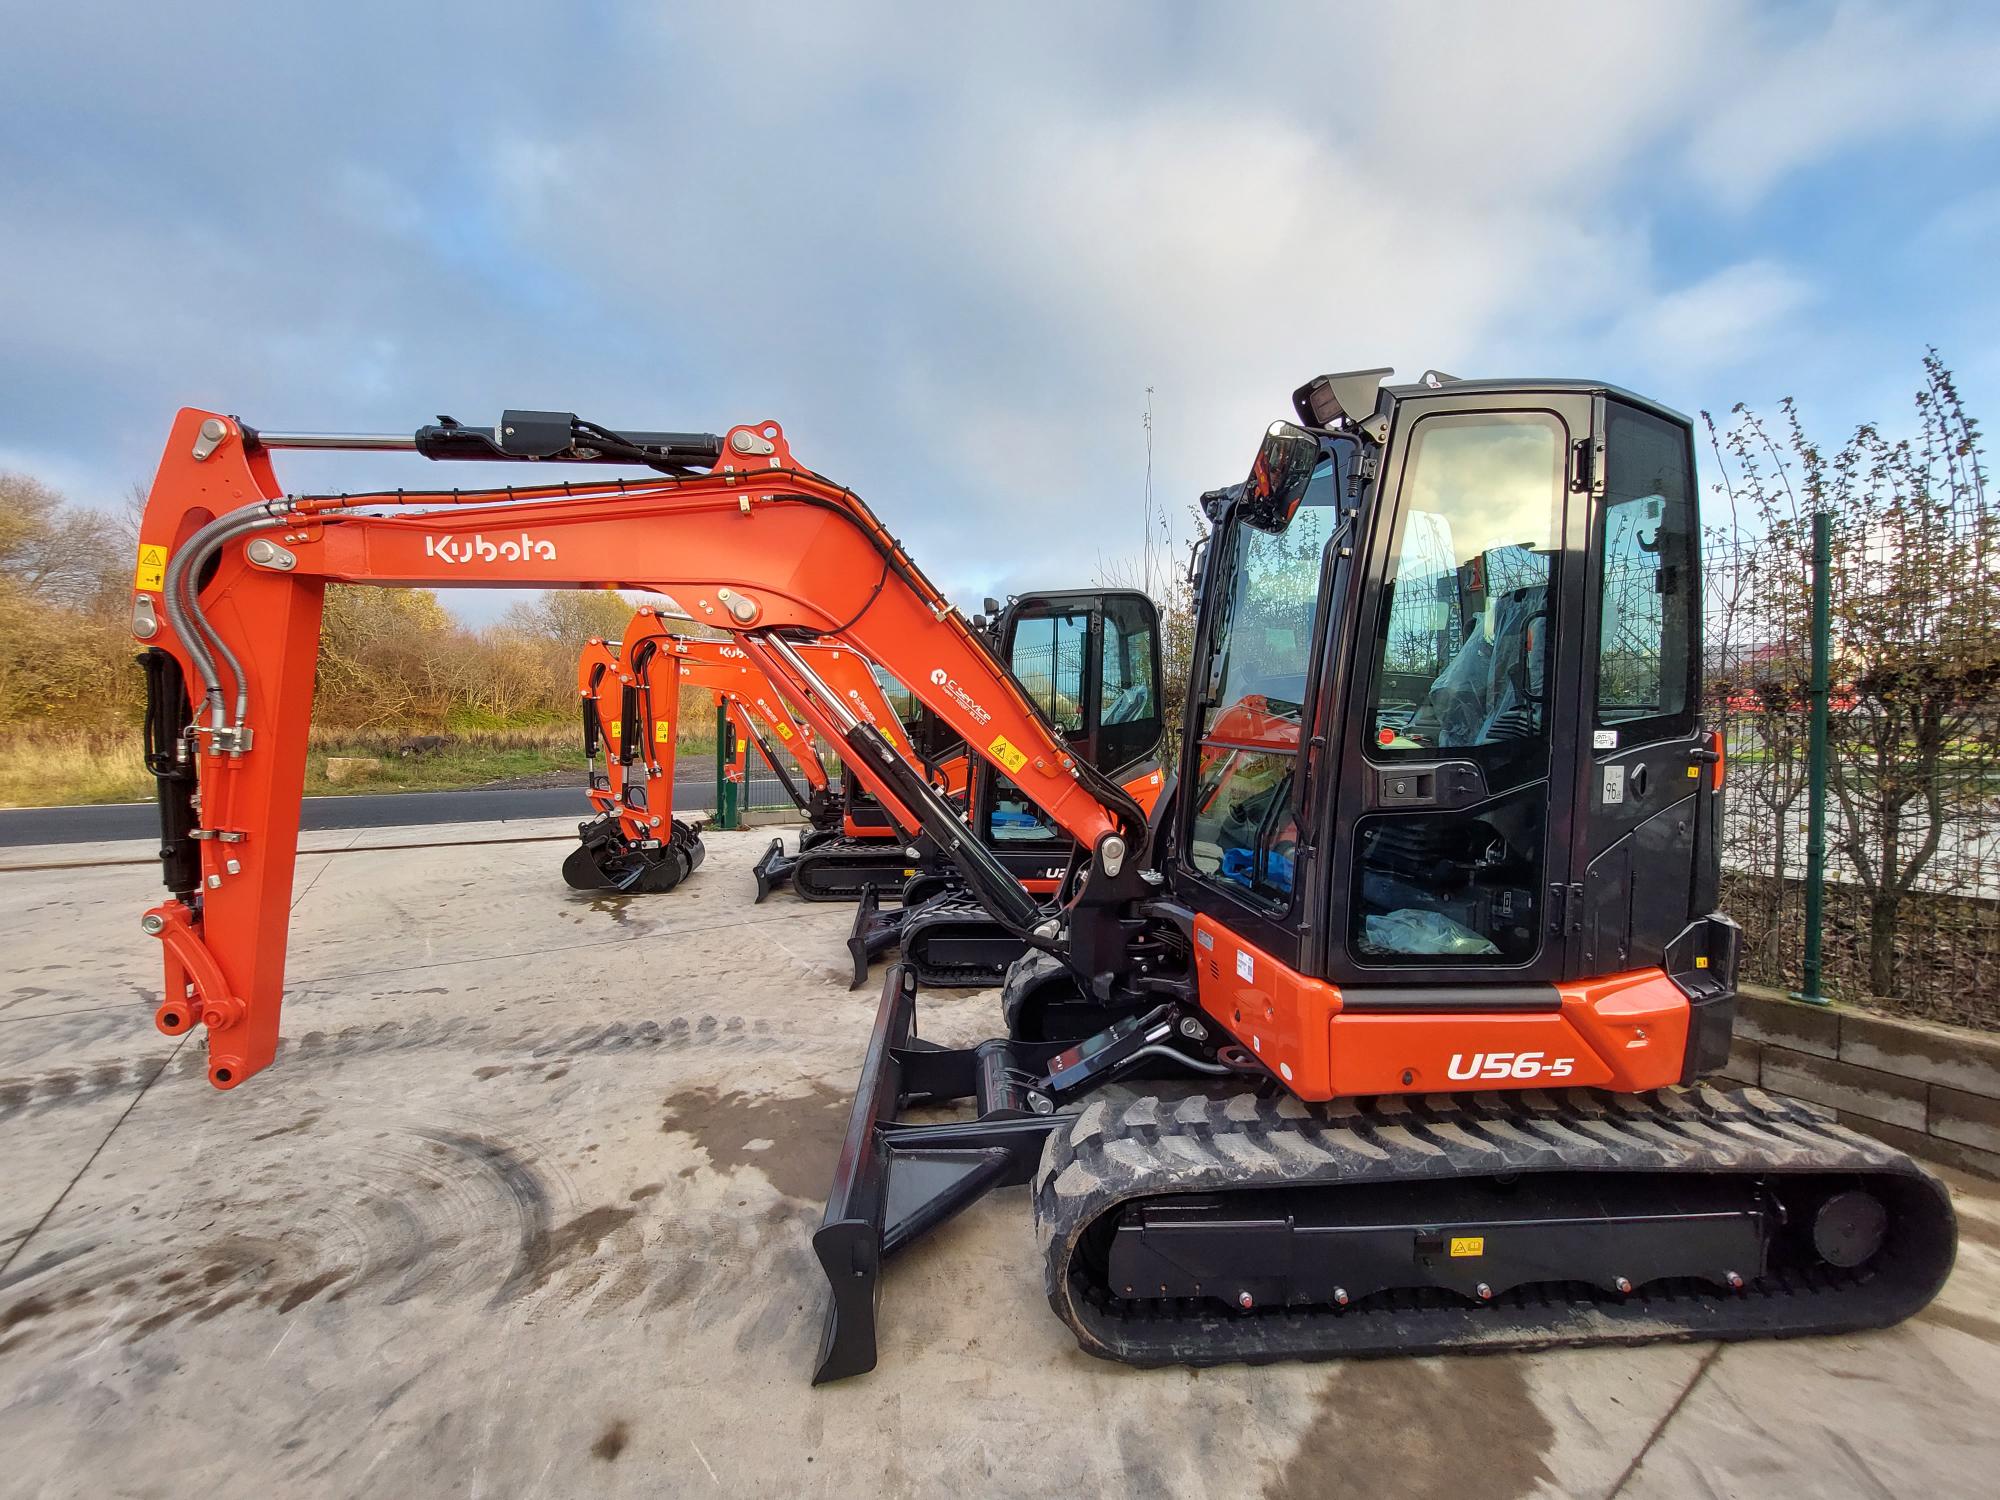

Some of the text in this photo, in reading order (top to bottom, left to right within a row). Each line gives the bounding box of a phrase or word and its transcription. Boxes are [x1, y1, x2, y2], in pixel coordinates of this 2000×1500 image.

[425, 533, 557, 564] Kubota
[1605, 782, 1617, 800] 96
[1447, 1051, 1575, 1080] U56-5
